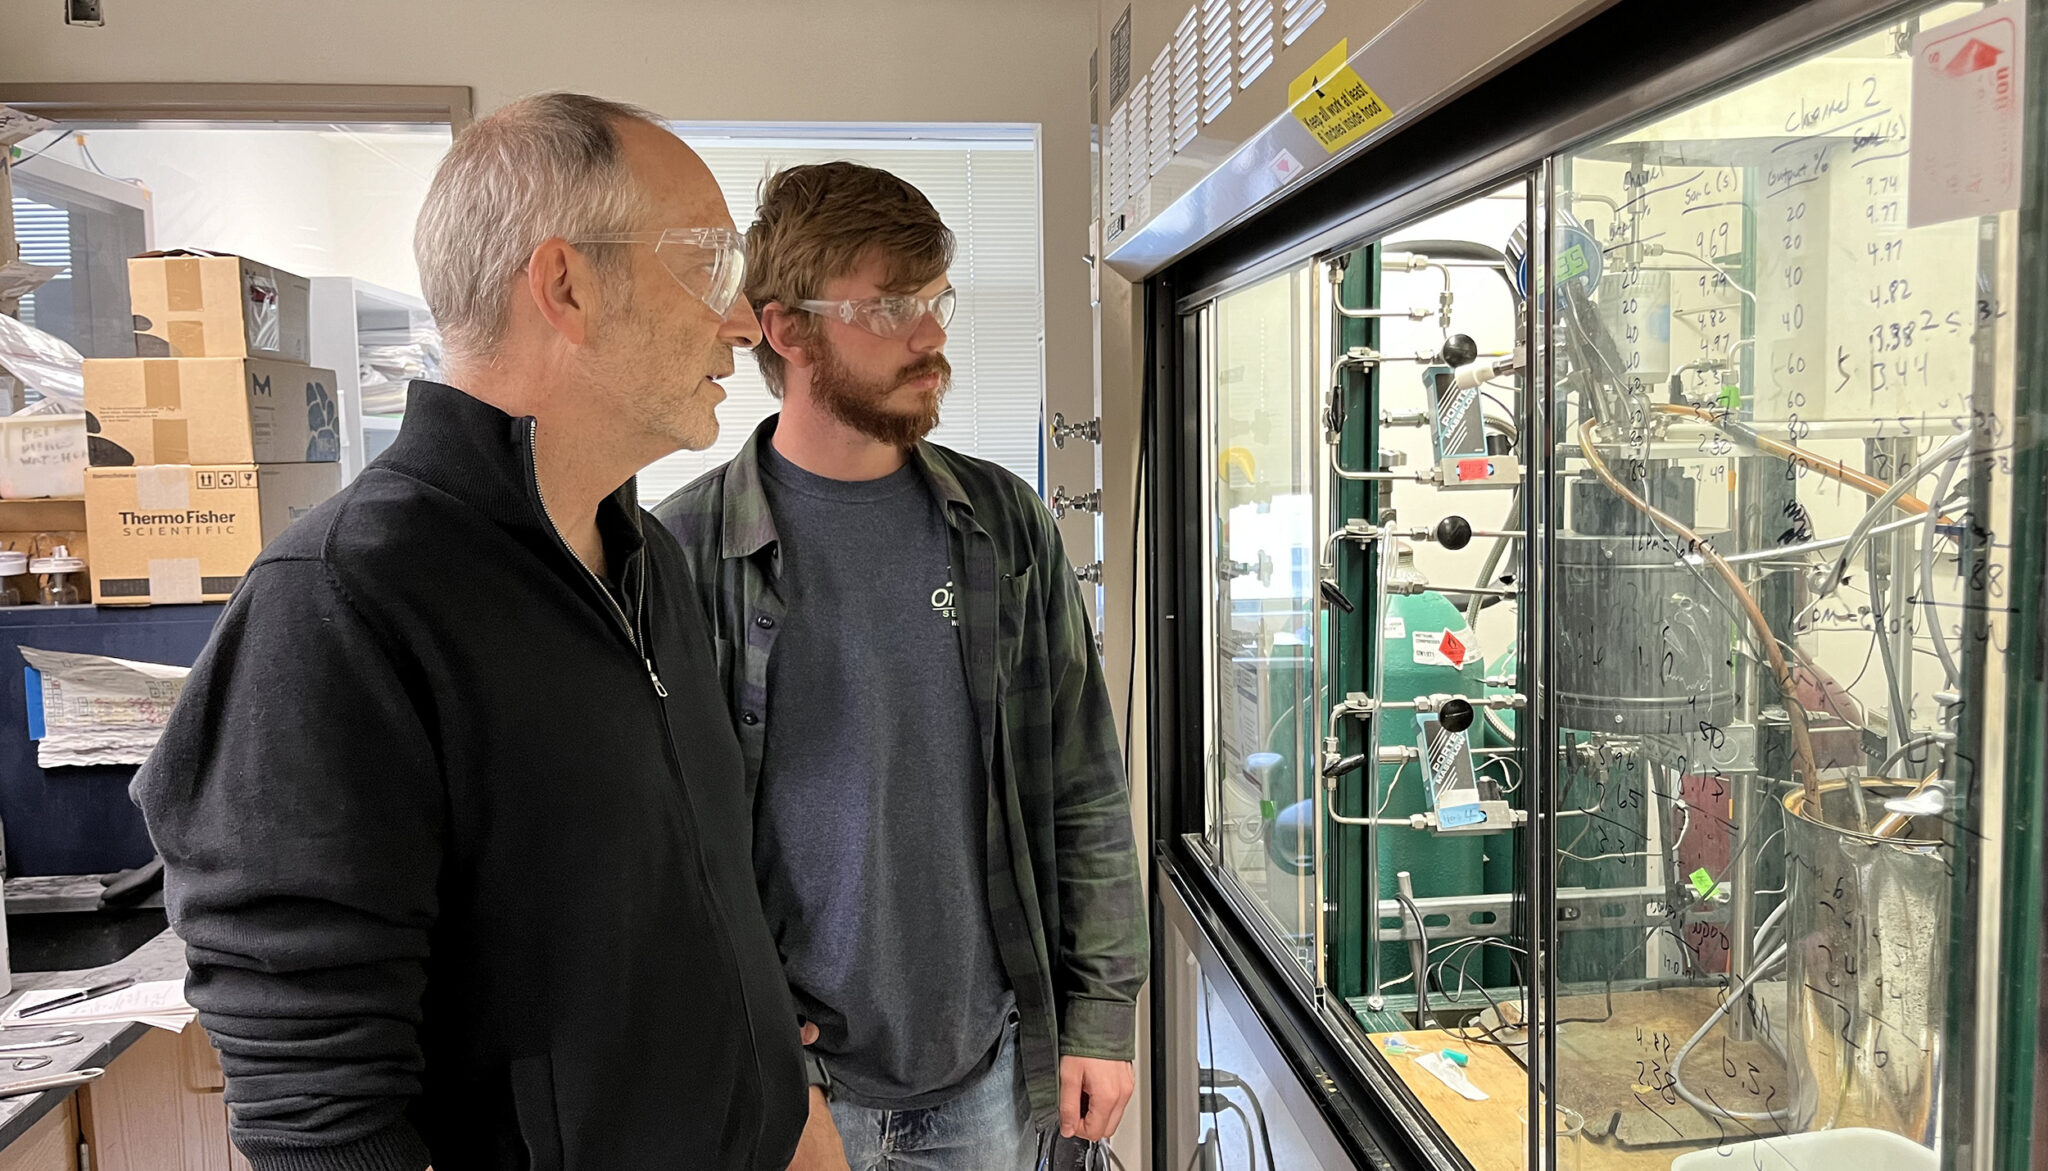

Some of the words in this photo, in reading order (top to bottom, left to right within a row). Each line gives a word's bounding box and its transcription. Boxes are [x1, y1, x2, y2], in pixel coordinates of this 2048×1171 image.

[1340, 92, 1352, 107] at
[1344, 81, 1368, 102] least
[1863, 77, 1880, 107] 2
[1318, 106, 1331, 122] all
[1326, 97, 1346, 117] work
[1303, 113, 1325, 132] Keep
[1324, 121, 1347, 142] inches
[1341, 110, 1365, 131] inside
[1357, 97, 1382, 120] hood
[1866, 176, 1897, 196] 9.74
[1786, 202, 1805, 222] 20
[1697, 222, 1728, 259] 9.69
[1782, 235, 1801, 250] 20
[1621, 266, 1638, 290] 20
[1784, 266, 1801, 289] 40
[1870, 279, 1912, 307] 4.82
[1622, 298, 1637, 314] 20
[1698, 309, 1726, 328] 4.82
[1782, 304, 1803, 330] 40
[1626, 325, 1638, 344] 40
[1788, 353, 1805, 374] 60
[252, 372, 272, 398] M
[1787, 392, 1806, 409] 60
[1787, 413, 1809, 440] 80
[1786, 453, 1808, 480] 80
[122, 526, 235, 537] SCIENTIFIC
